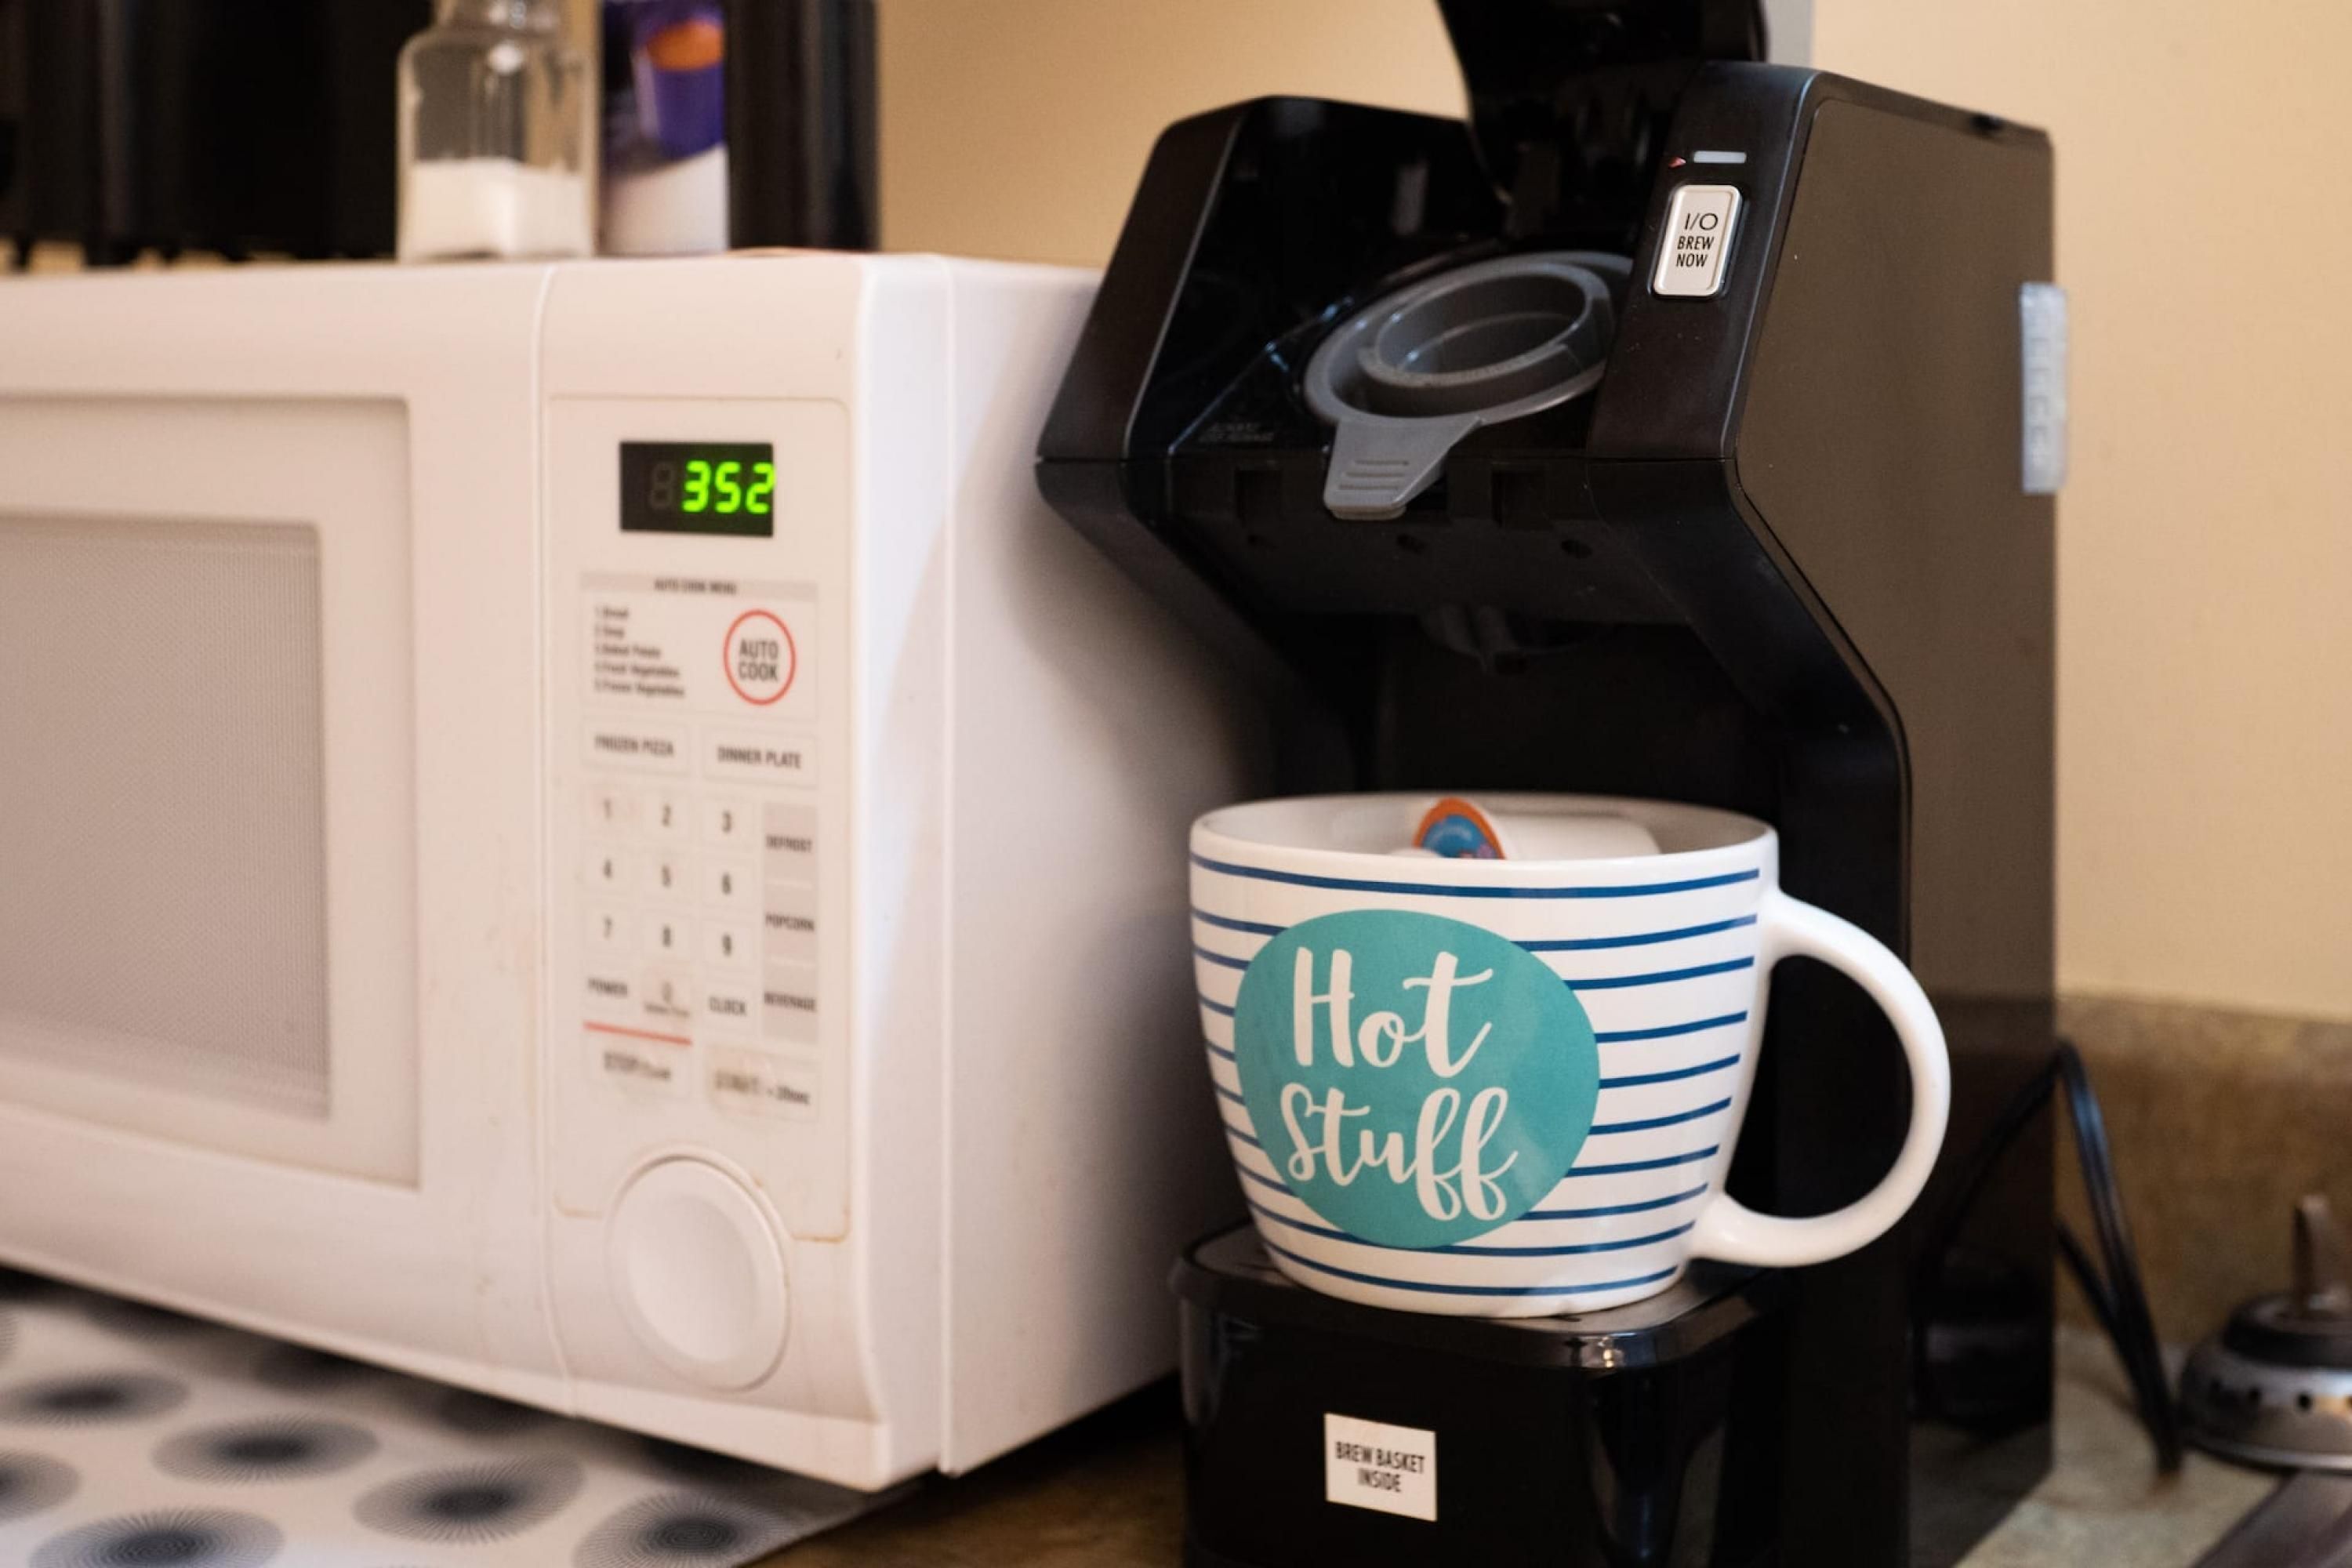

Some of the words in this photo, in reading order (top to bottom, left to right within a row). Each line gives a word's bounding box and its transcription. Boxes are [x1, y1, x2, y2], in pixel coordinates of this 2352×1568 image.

[1684, 212, 1719, 230] I/O
[1677, 236, 1714, 250] BREW
[1675, 252, 1708, 267] NOW
[682, 459, 776, 514] 352
[739, 640, 779, 659] AUTO
[738, 662, 778, 681] COOK
[594, 735, 638, 754] FROZEN
[642, 739, 674, 758] PIZZA
[717, 746, 760, 765] DINNER
[765, 750, 801, 770] PLATE
[603, 799, 612, 820] 1
[662, 804, 672, 827] 2
[722, 810, 732, 833] 3
[765, 834, 813, 854] DEFROST
[603, 858, 612, 880] 4
[662, 865, 672, 888] 5
[721, 873, 732, 895] 6
[603, 916, 612, 939] 7
[765, 912, 815, 932] POPCORN
[662, 924, 672, 948] 8
[722, 933, 733, 956] 9
[588, 978, 628, 997] POWER
[709, 996, 746, 1016] CLOCK
[764, 990, 817, 1012] BEVERAGE
[1293, 946, 1494, 1078] Hot
[1280, 1083, 1519, 1221] Stuff
[1336, 1441, 1372, 1463] BREW
[1376, 1449, 1425, 1474] BASKET
[1358, 1468, 1401, 1493] INSIDE
